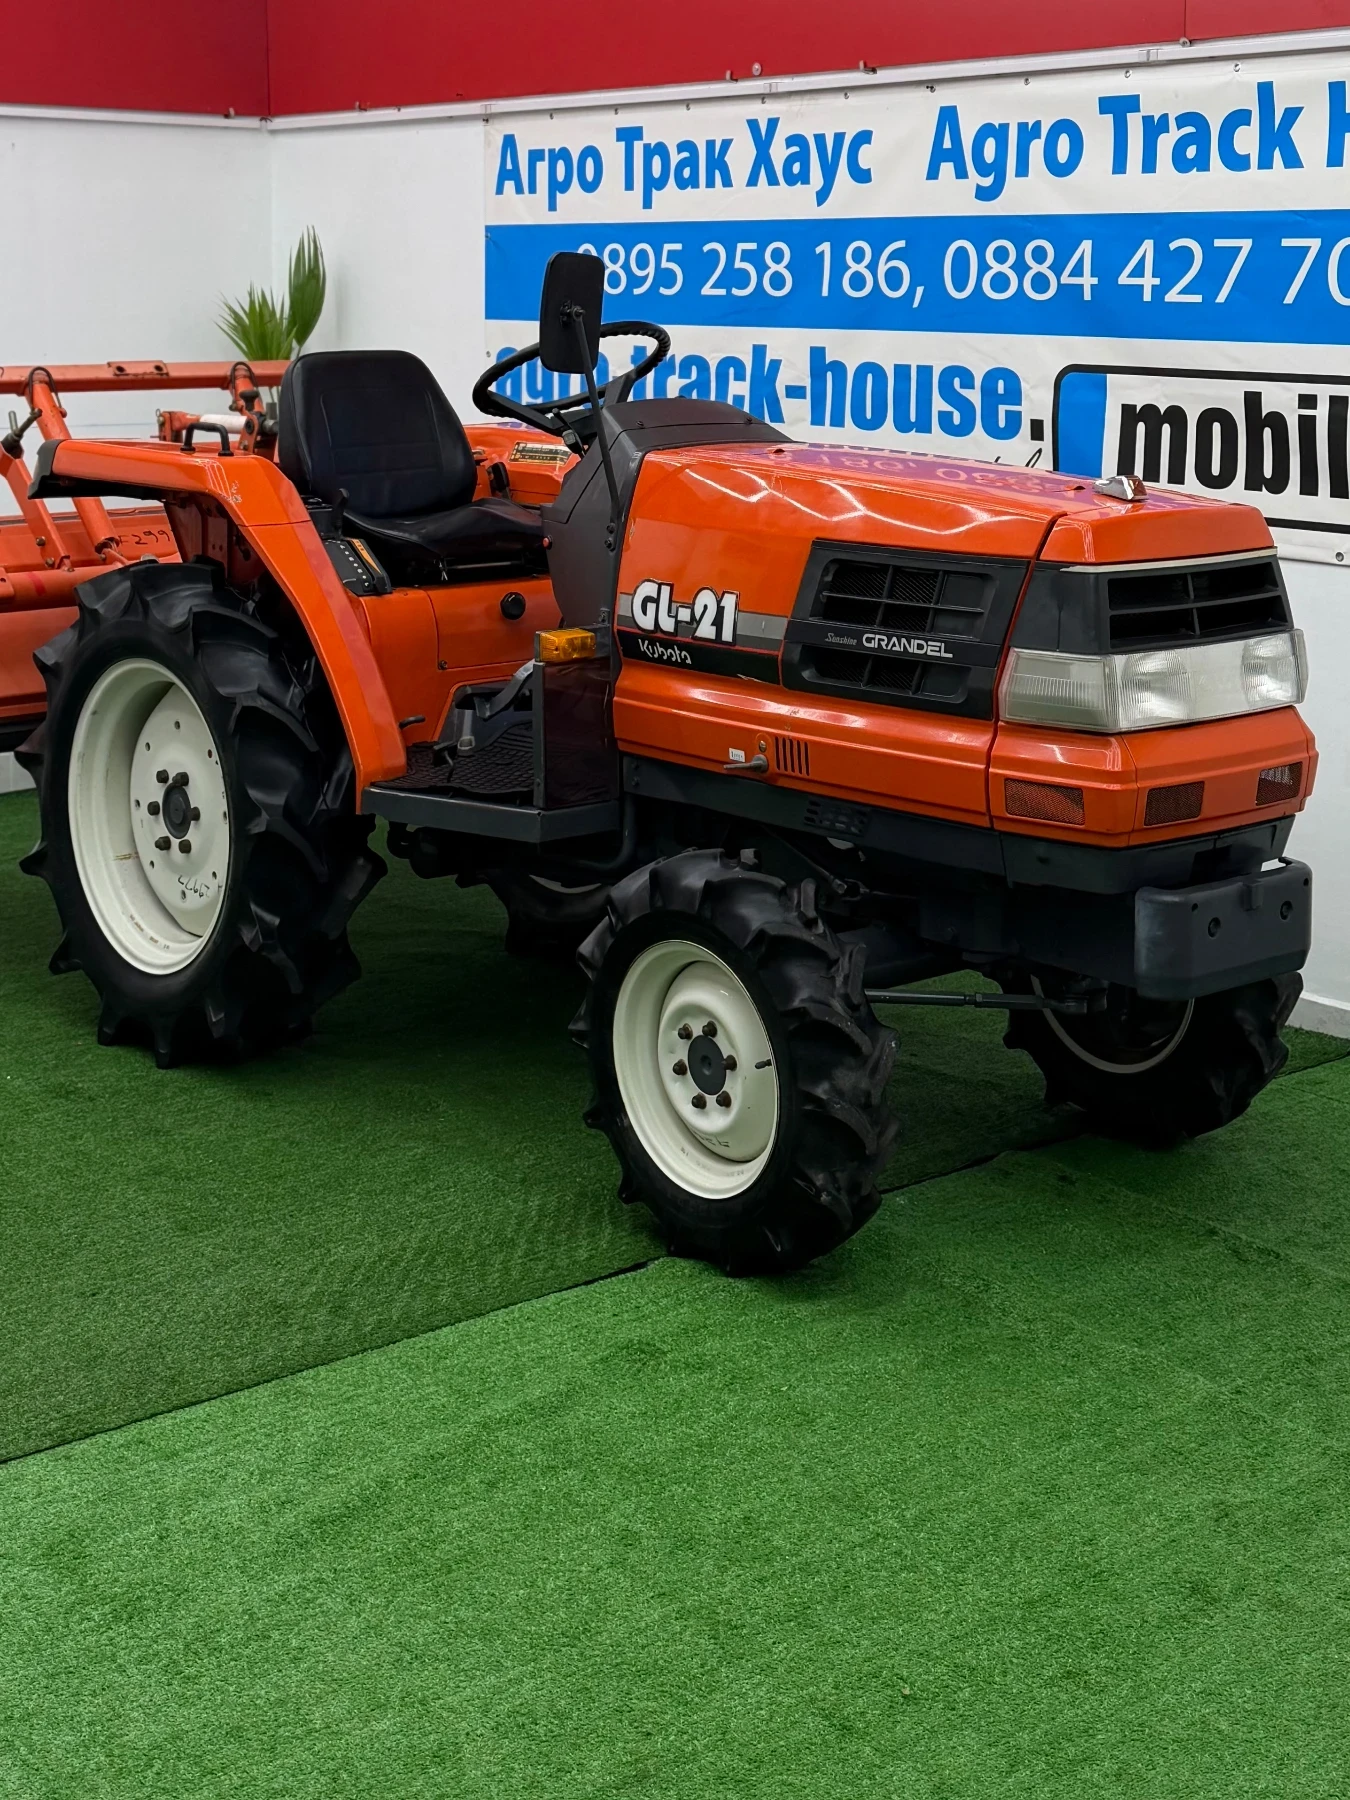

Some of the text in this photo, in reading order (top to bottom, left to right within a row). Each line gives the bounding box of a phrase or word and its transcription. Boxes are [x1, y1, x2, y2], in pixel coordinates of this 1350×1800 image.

[495, 117, 873, 212] Агро Трак Хаус
[925, 105, 1084, 202] Agro
[1098, 81, 1305, 175] Track
[577, 242, 684, 298] 895
[701, 241, 793, 298] 258
[815, 240, 926, 308] 186,
[943, 239, 1099, 301] 0884
[1117, 238, 1253, 304] 427
[1116, 390, 1350, 500] mobil
[631, 578, 739, 646] GL-21
[862, 633, 953, 658] GRANDEL
[638, 638, 692, 665] Kubota
